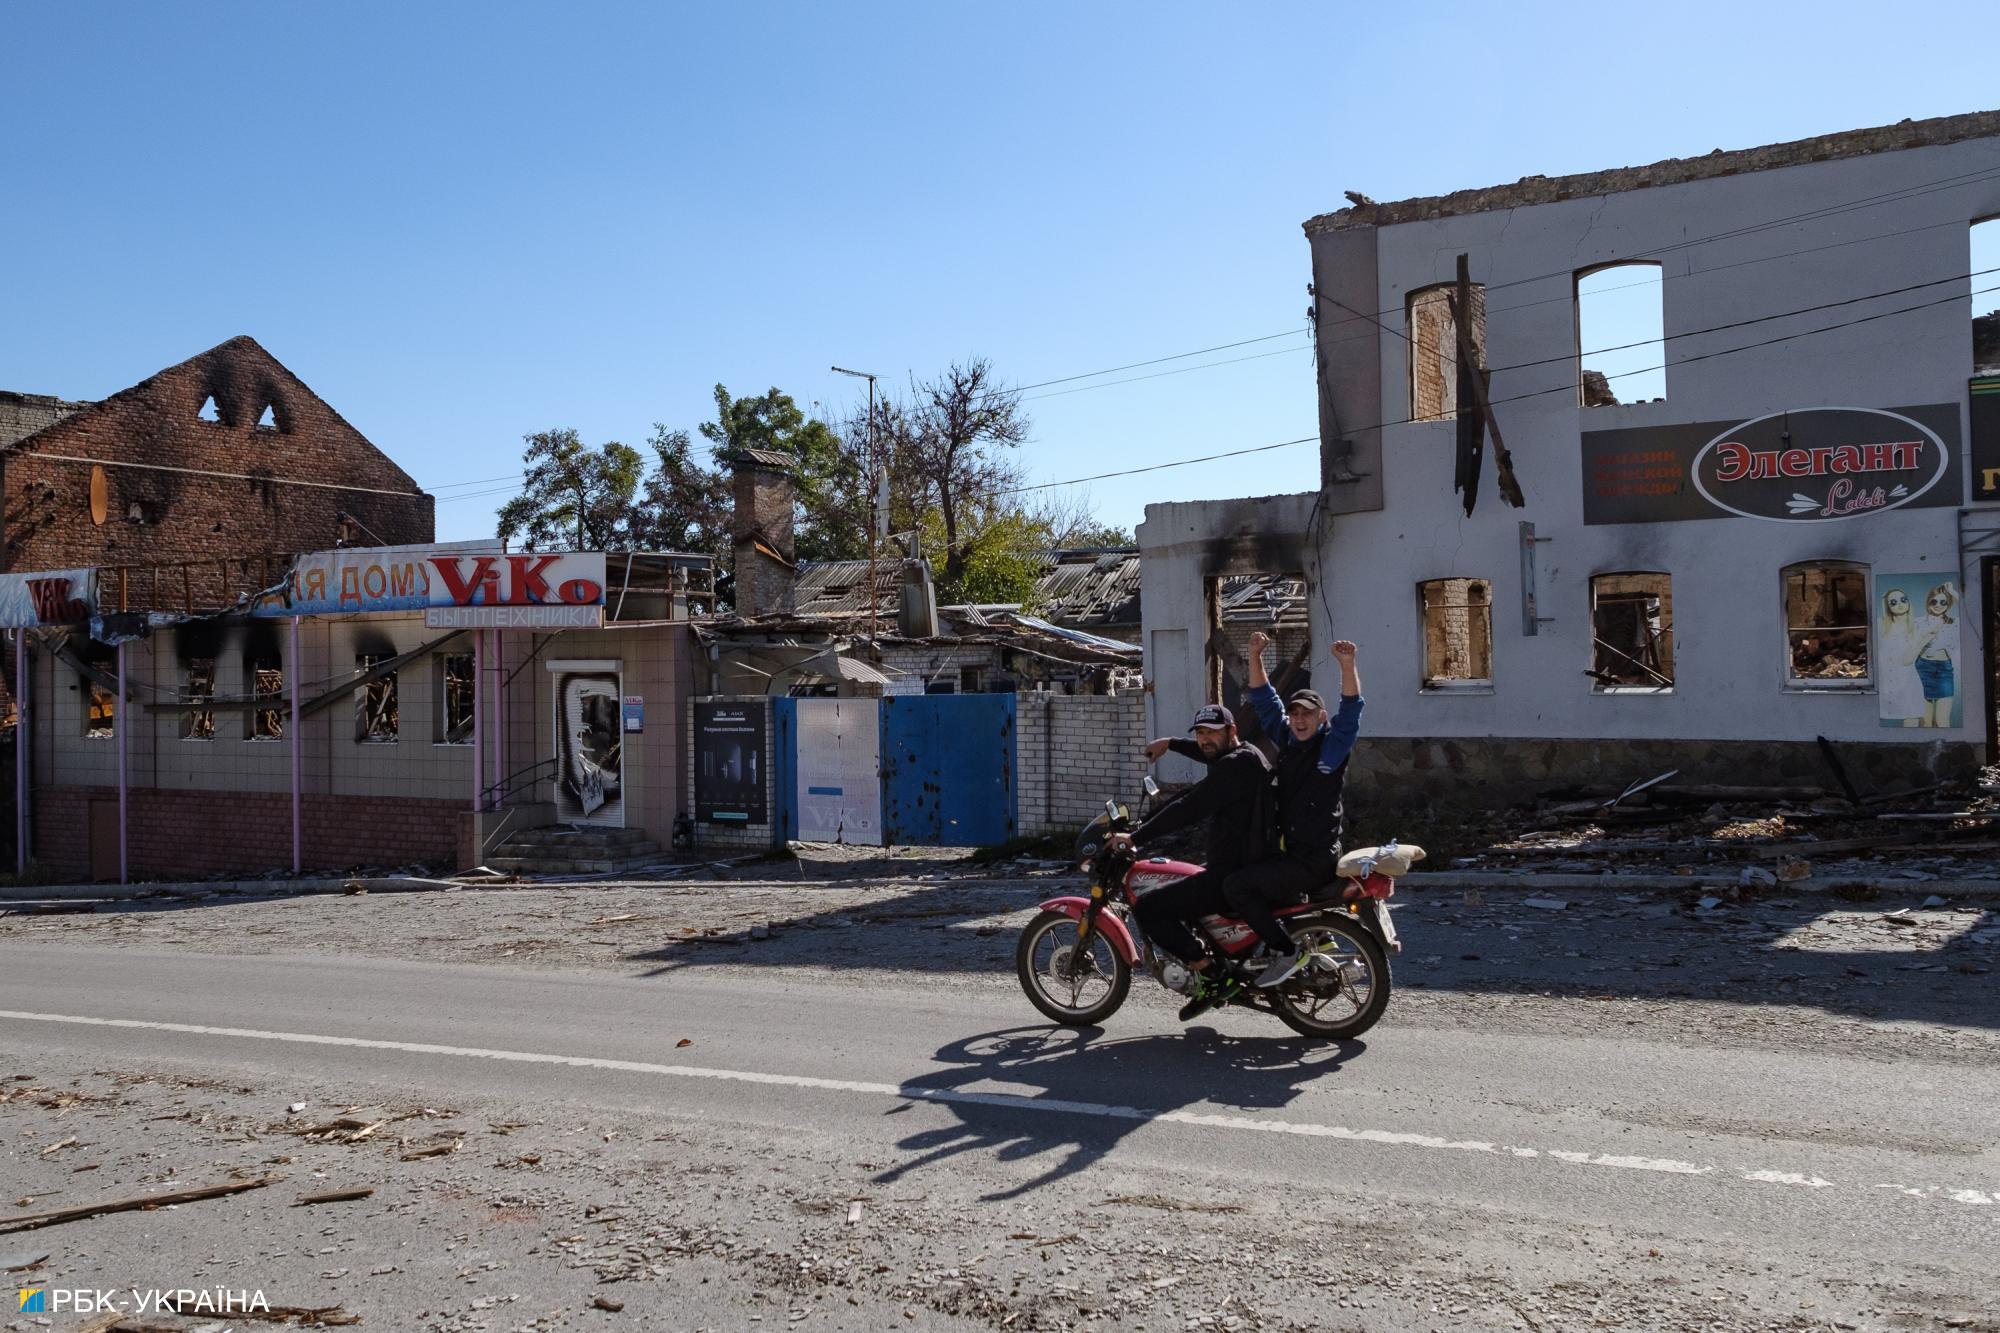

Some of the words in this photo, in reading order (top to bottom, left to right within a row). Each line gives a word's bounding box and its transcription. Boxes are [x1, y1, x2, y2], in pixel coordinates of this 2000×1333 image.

[1716, 440, 1924, 482] Элегант
[339, 562, 431, 607] ДОМУ
[427, 555, 602, 606] ViKo
[427, 607, 601, 628] БЫТТЕХНИКА
